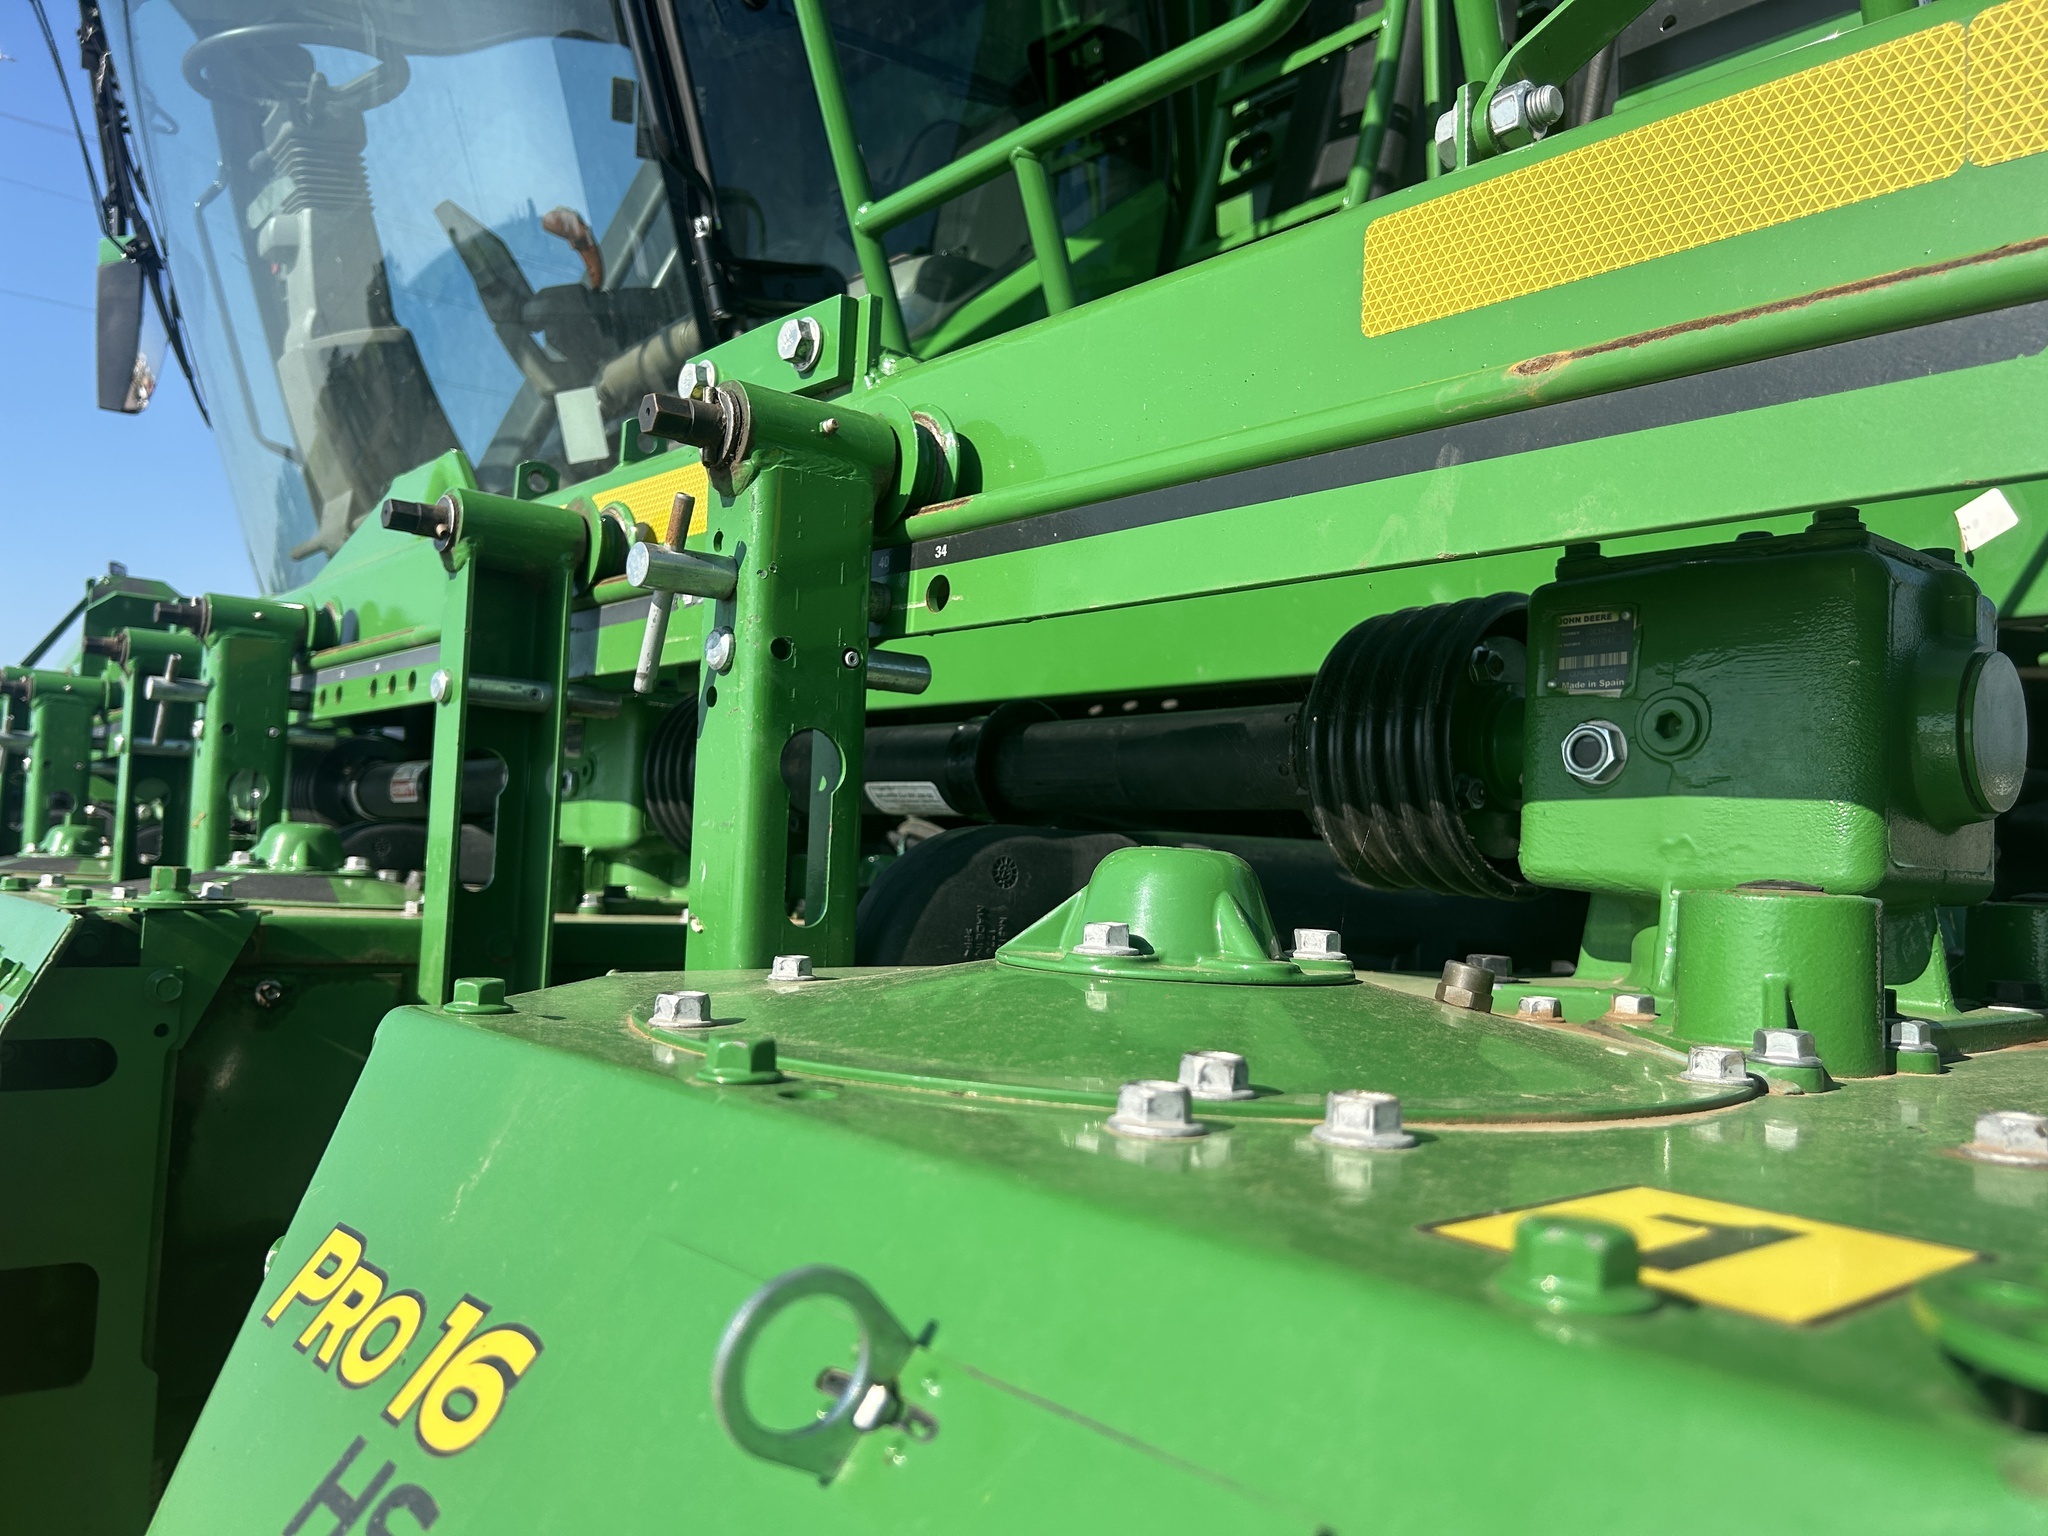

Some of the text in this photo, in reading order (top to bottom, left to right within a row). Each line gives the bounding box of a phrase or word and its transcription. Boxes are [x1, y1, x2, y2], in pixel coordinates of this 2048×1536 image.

[934, 543, 948, 559] 34
[1558, 613, 1612, 626] JOHN DEERE
[1562, 678, 1625, 690] Made in Spain
[261, 1222, 546, 1459] PRO 16
